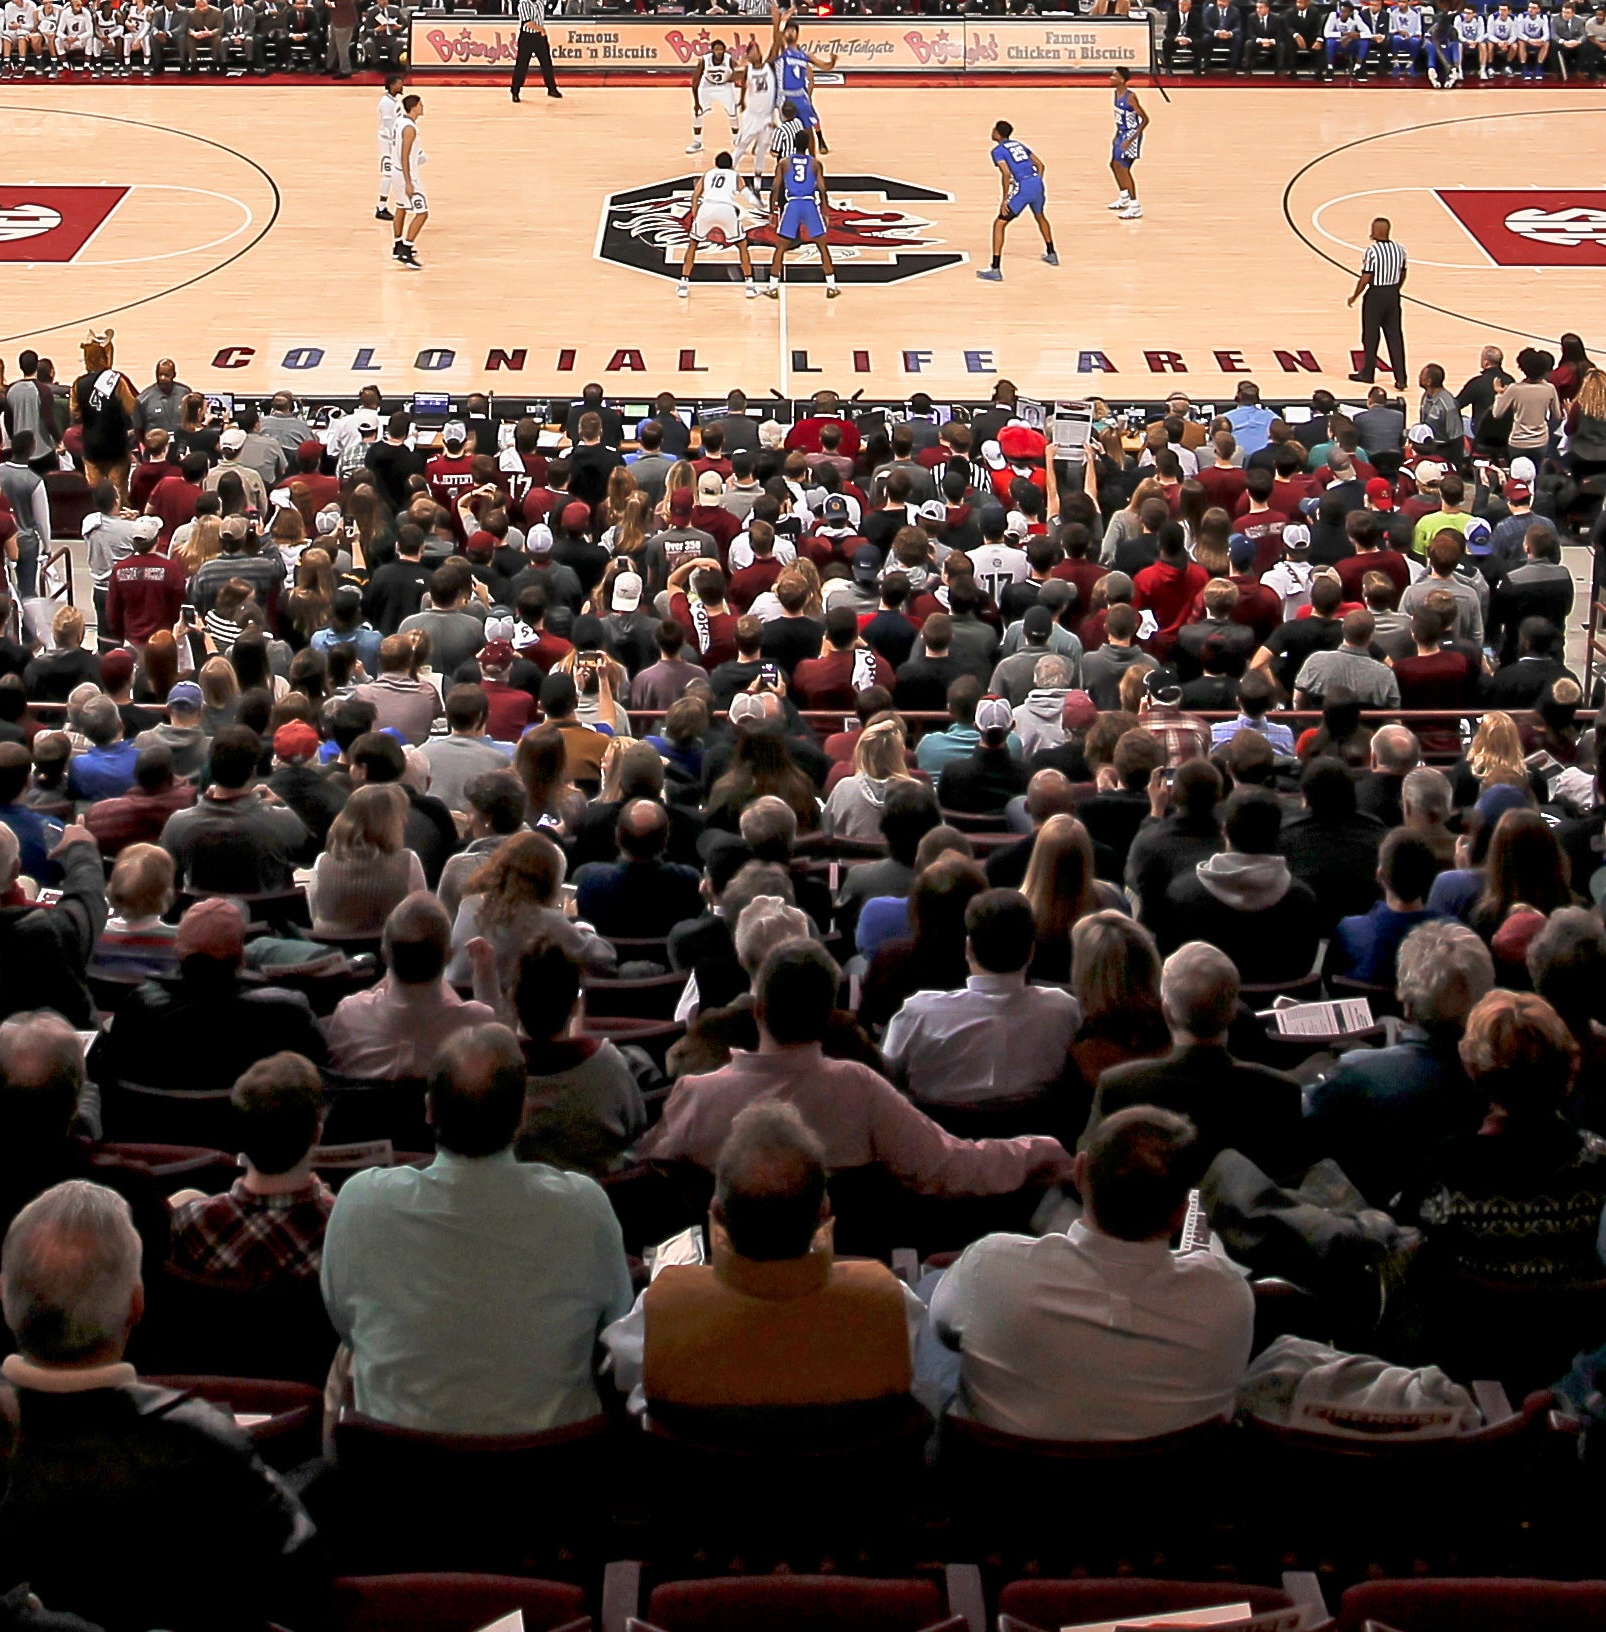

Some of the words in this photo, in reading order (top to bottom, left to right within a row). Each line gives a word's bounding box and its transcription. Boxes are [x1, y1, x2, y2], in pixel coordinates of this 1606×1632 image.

[567, 30, 620, 44] Famous
[1045, 31, 1097, 45] Famous
[602, 45, 658, 60] Biscuits
[1006, 45, 1062, 61] Chicken
[1081, 45, 1136, 61] Biscuits
[1010, 145, 1029, 163] 25
[793, 164, 806, 183] 3
[710, 175, 726, 190] 10
[212, 347, 709, 372] COLONIAL
[791, 350, 996, 373] LIFE
